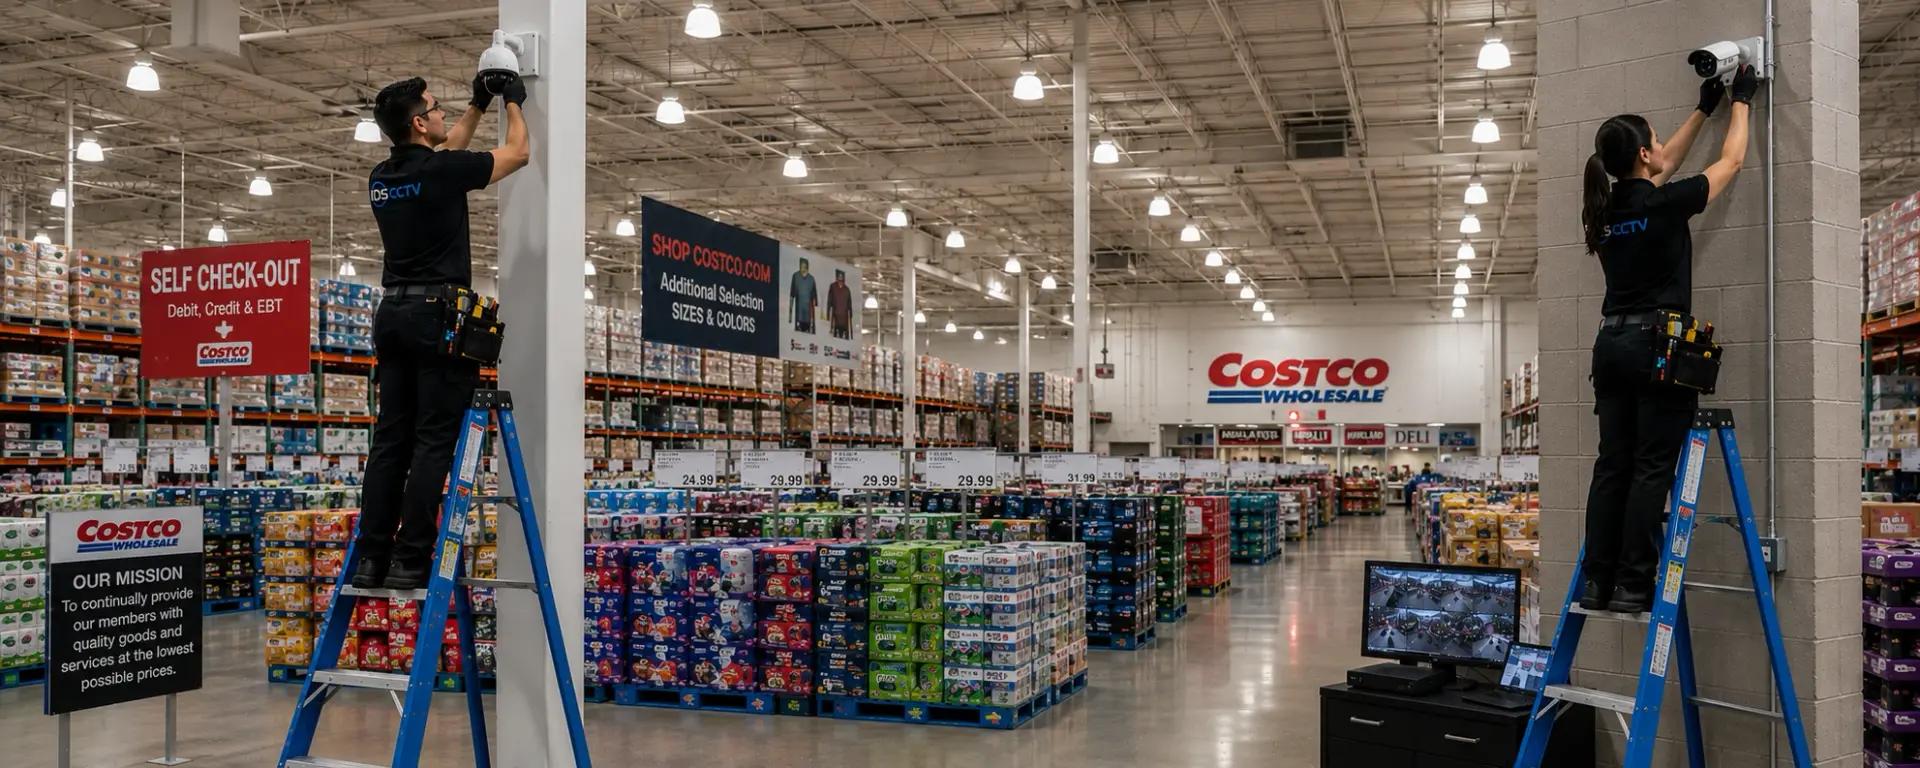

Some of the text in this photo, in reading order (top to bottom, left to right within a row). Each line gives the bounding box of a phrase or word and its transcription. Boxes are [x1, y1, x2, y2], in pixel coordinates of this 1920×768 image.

[389, 182, 421, 199] CCTV
[1612, 217, 1648, 236] CCTV
[652, 233, 771, 284] SHOP COSTCO.COM
[150, 258, 301, 294] SELF CHECK-OUT
[660, 272, 764, 312] Additional Selection
[168, 299, 283, 319] Debit, Credit & EBT
[672, 302, 756, 334] SIZES & COLORS
[200, 346, 250, 358] COSTCO
[1208, 352, 1389, 387] COSTCO
[1262, 389, 1386, 404] WHOLESALE
[1395, 430, 1430, 444] DELI
[682, 474, 714, 486] 24.99
[770, 474, 803, 486] 29.99
[863, 475, 898, 487] 29.99
[957, 475, 993, 487] 29.99
[1068, 473, 1095, 483] 31.99
[77, 519, 182, 543] COSTCO
[113, 538, 178, 551] WHOLESALE
[73, 566, 183, 590] OUR MISSION
[62, 586, 194, 613] To continually provide
[73, 606, 183, 632] our members with
[73, 624, 183, 653] quality goods and
[61, 642, 194, 673] services at the lowest
[80, 668, 177, 692] possible prices.
